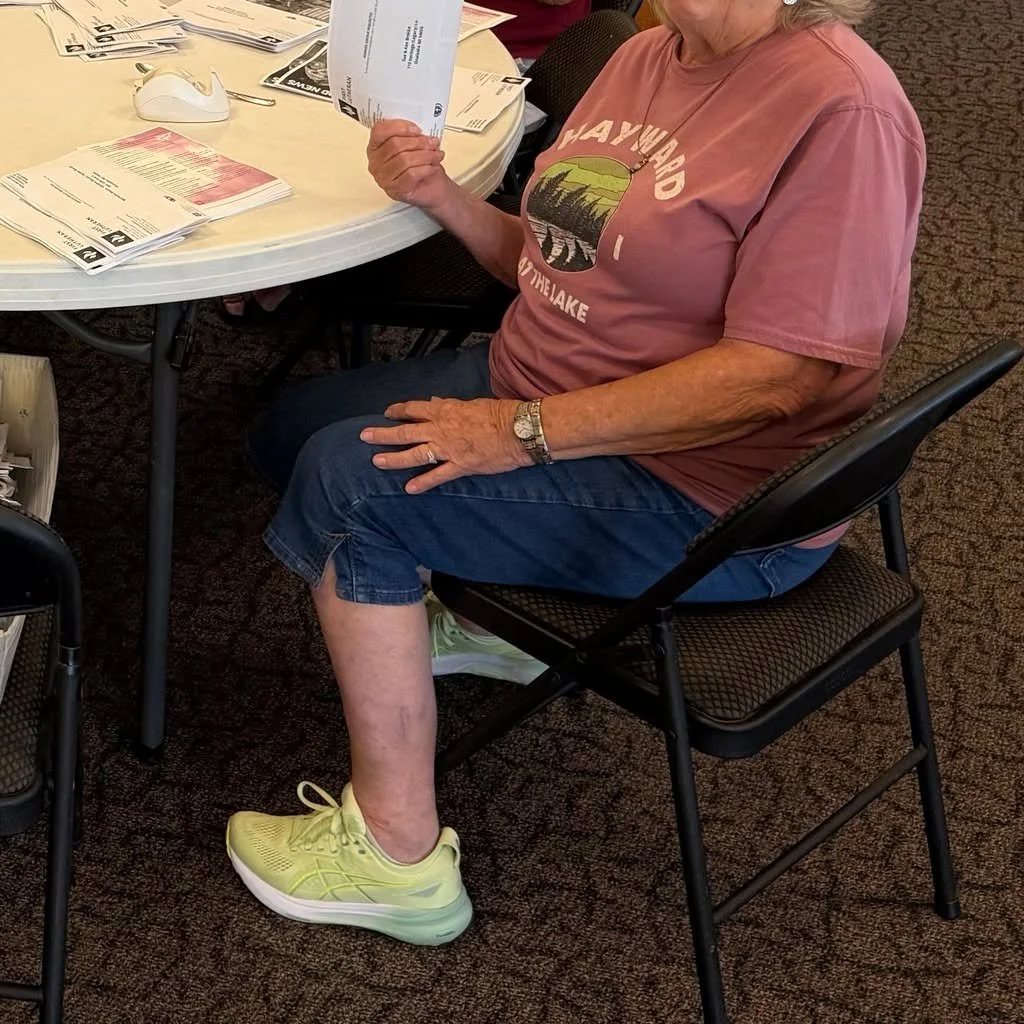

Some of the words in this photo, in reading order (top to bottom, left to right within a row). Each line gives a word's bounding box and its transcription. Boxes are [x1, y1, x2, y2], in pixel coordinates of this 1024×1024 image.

[287, 79, 321, 93] NEWS
[529, 270, 551, 297] THE
[551, 283, 590, 324] LAKE
